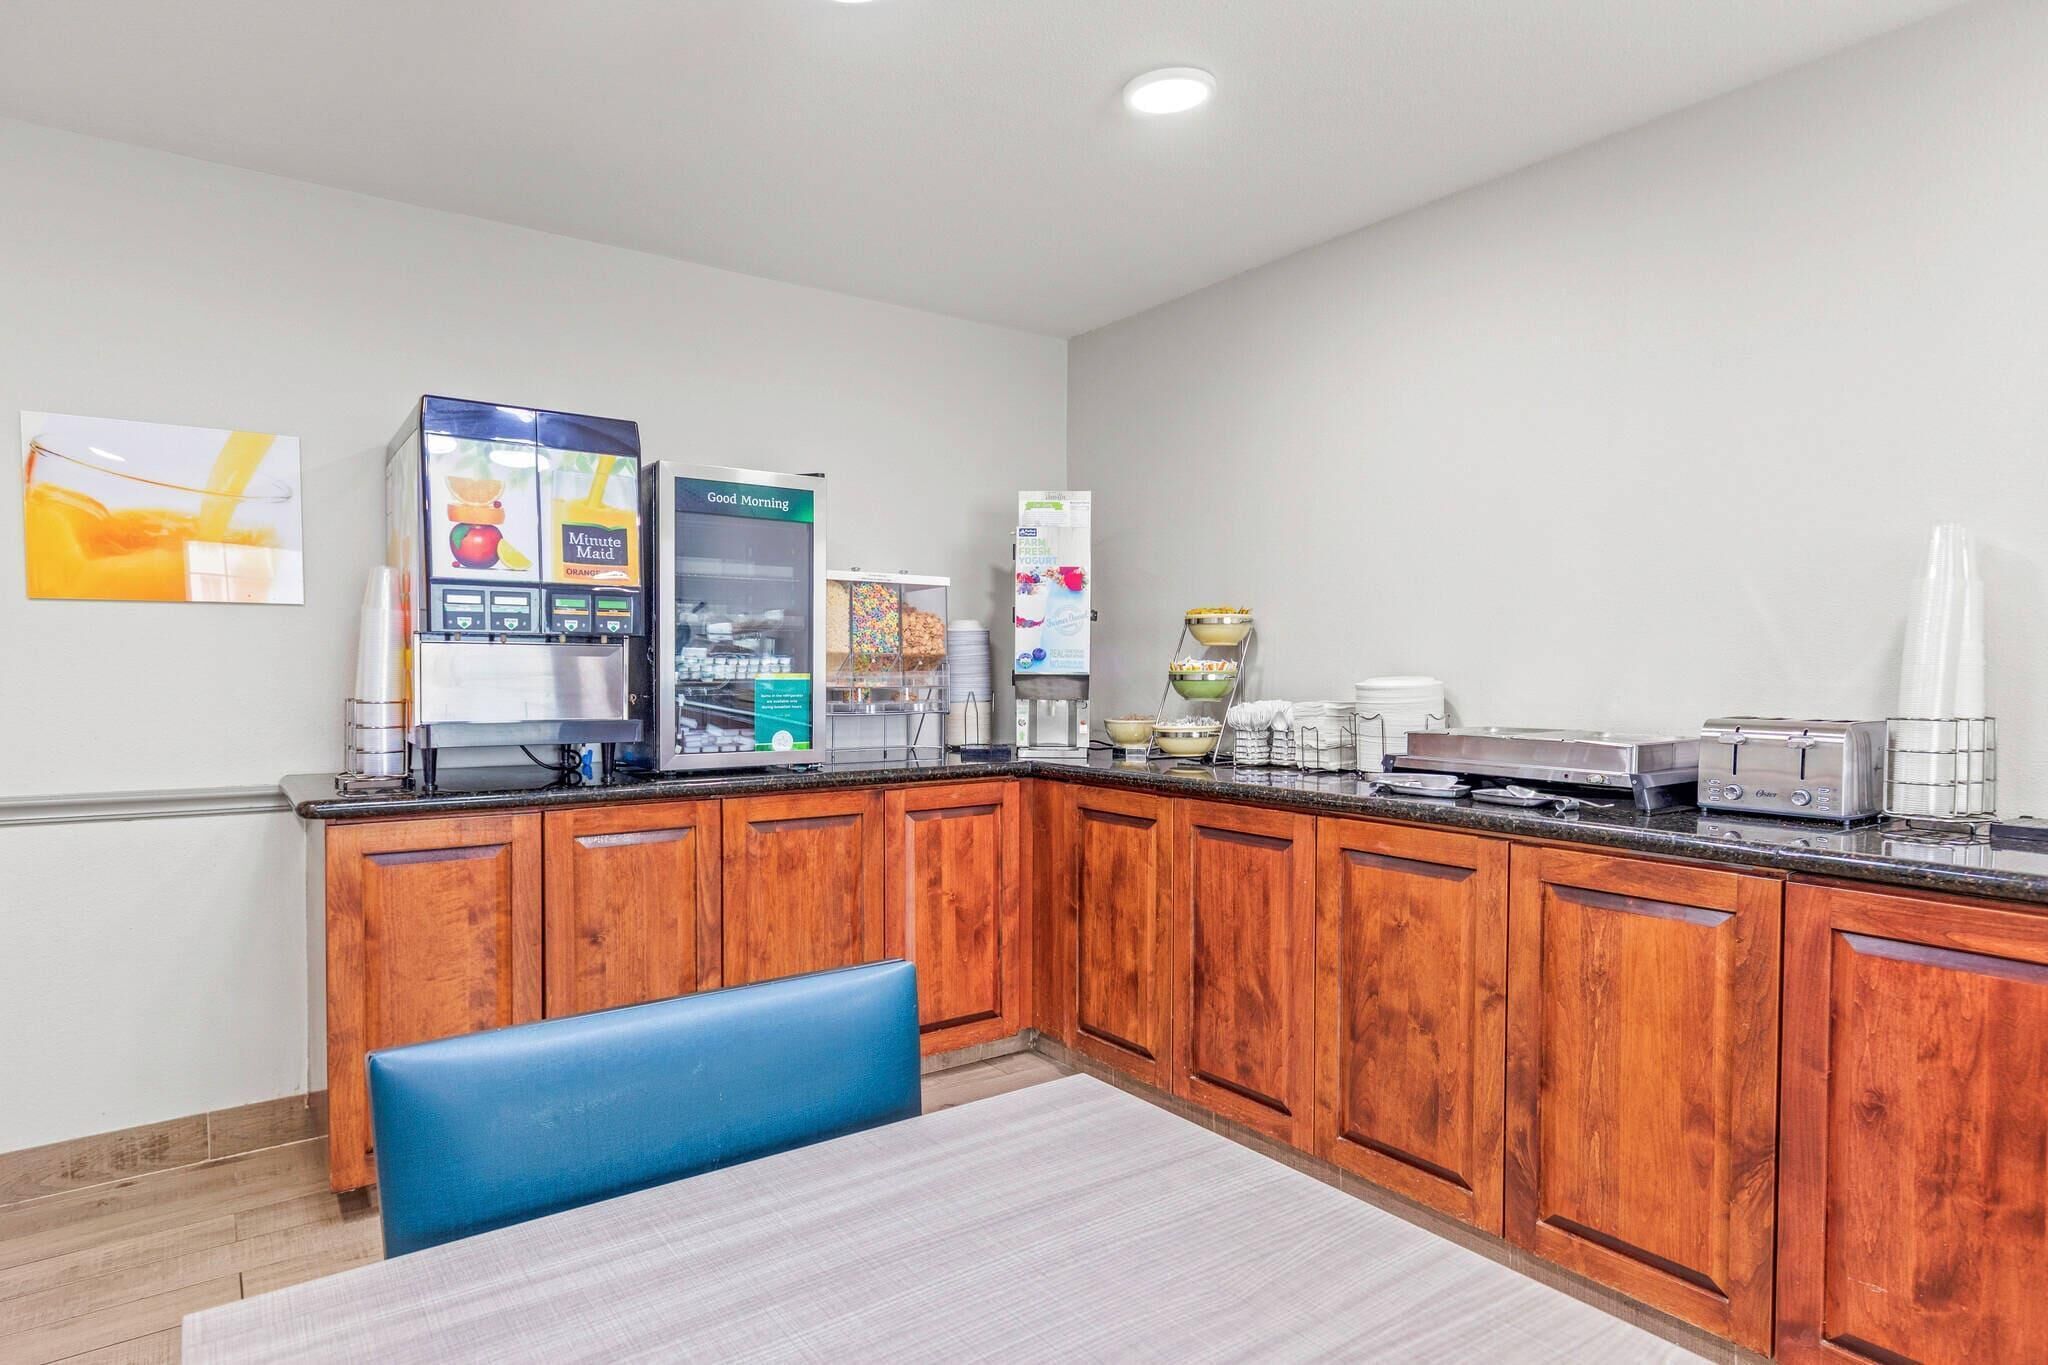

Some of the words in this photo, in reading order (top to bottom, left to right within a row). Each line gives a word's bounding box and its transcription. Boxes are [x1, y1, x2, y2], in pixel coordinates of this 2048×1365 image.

[707, 492, 737, 504] Good
[741, 495, 789, 512] Morning
[568, 532, 622, 548] Minute
[1019, 538, 1046, 547] FARM
[576, 545, 616, 560] Maid
[1019, 547, 1051, 556] FRESH
[1019, 556, 1057, 565] YOGURT
